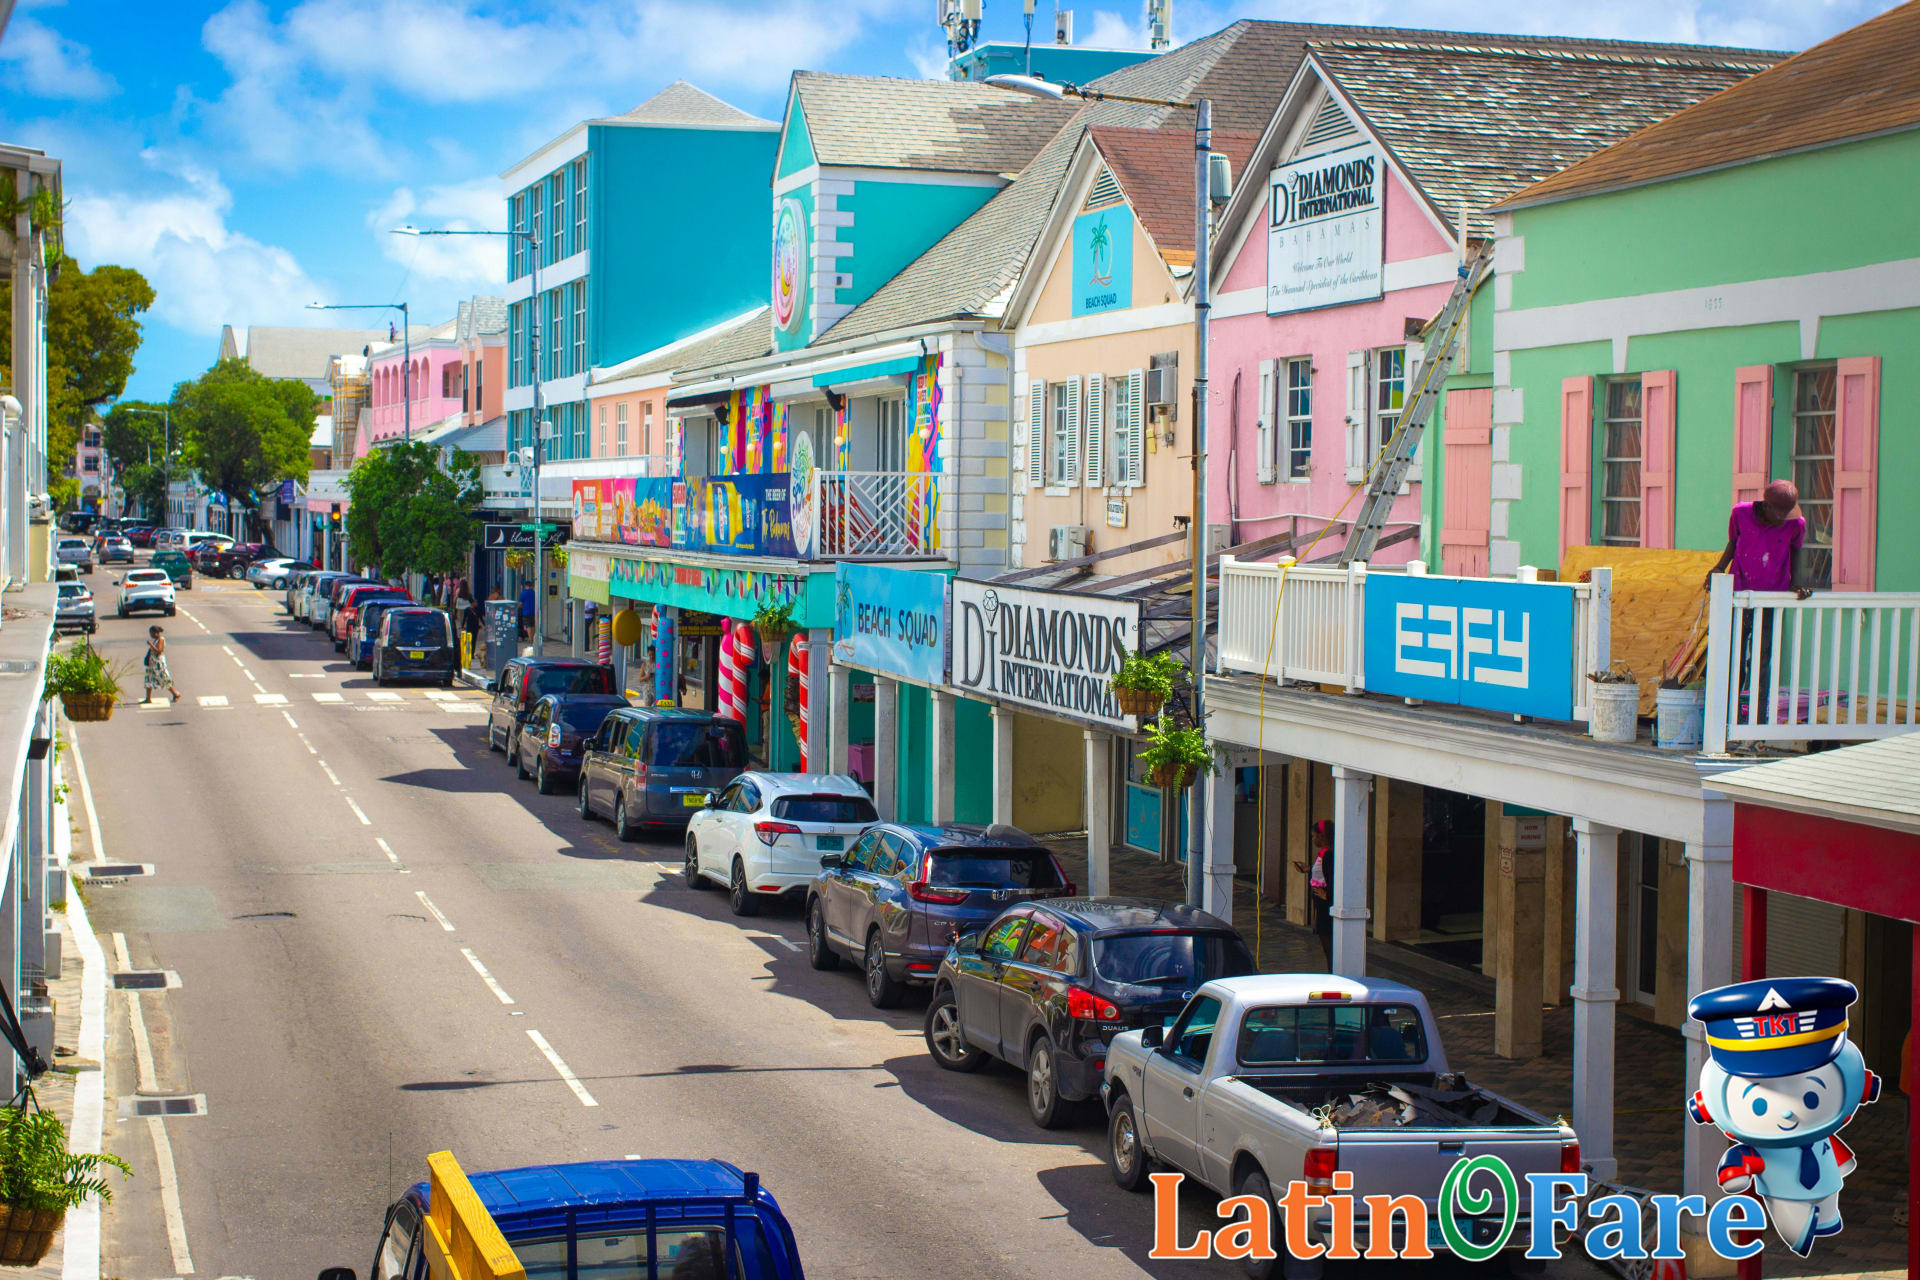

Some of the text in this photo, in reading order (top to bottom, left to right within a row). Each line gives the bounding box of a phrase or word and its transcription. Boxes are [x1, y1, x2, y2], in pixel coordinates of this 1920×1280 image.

[1298, 155, 1375, 201] DIAMONDS
[1299, 186, 1374, 220] INTERNATIONAL
[1279, 217, 1370, 248] BAHAMAS
[1293, 251, 1354, 273] Welcome To Our World
[1270, 285, 1281, 297] The
[1332, 274, 1340, 290] of
[1340, 274, 1349, 284] the
[1349, 269, 1378, 283] Caribbean
[1085, 293, 1117, 309] BEACH SQUAD
[769, 508, 790, 541] Bahamas
[857, 602, 938, 650] BEACH SQUAD
[1000, 602, 1126, 674] DIAMONDS
